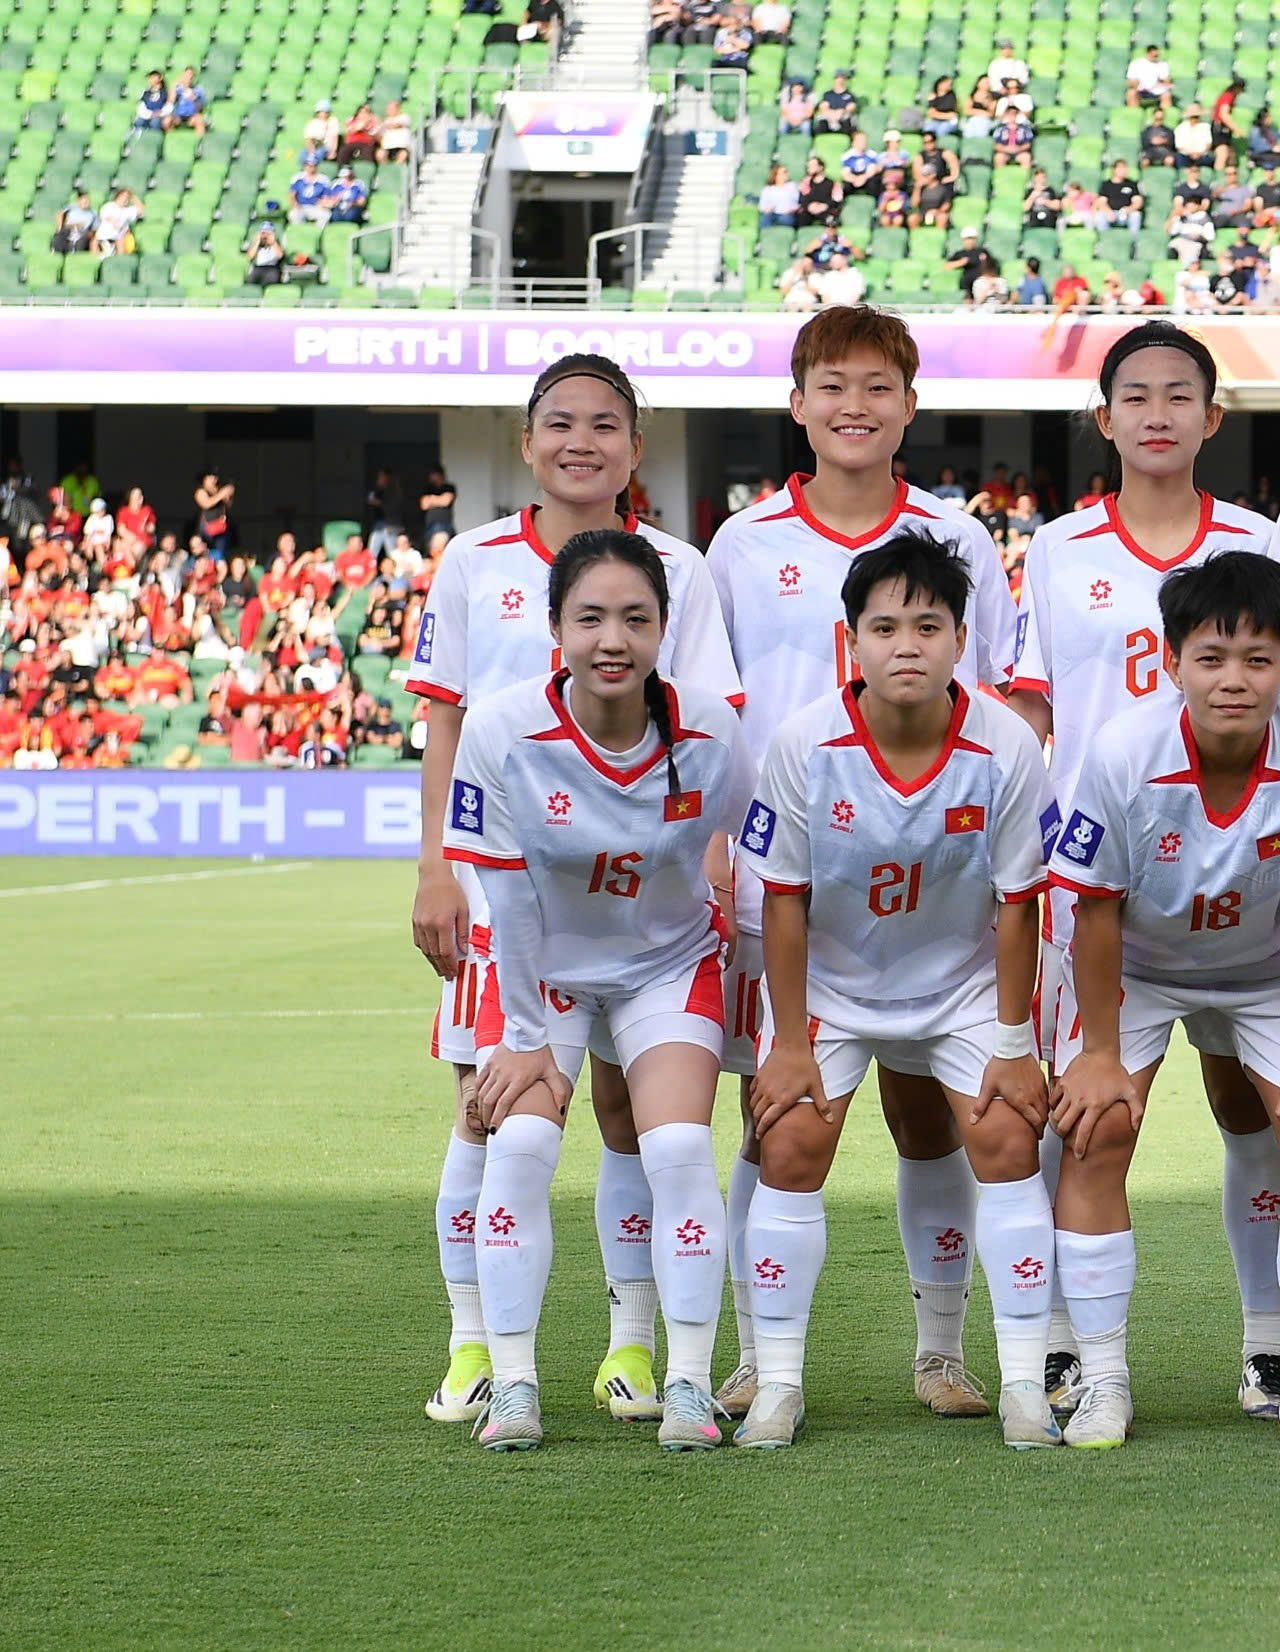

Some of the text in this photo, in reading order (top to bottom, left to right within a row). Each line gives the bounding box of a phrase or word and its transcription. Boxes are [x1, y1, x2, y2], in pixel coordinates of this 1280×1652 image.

[294, 326, 462, 366] PERTH
[505, 328, 754, 367] BOORLOO
[0, 785, 286, 844] PERTH
[588, 851, 644, 899] 15
[868, 862, 922, 918] 21
[1190, 890, 1241, 932] 18
